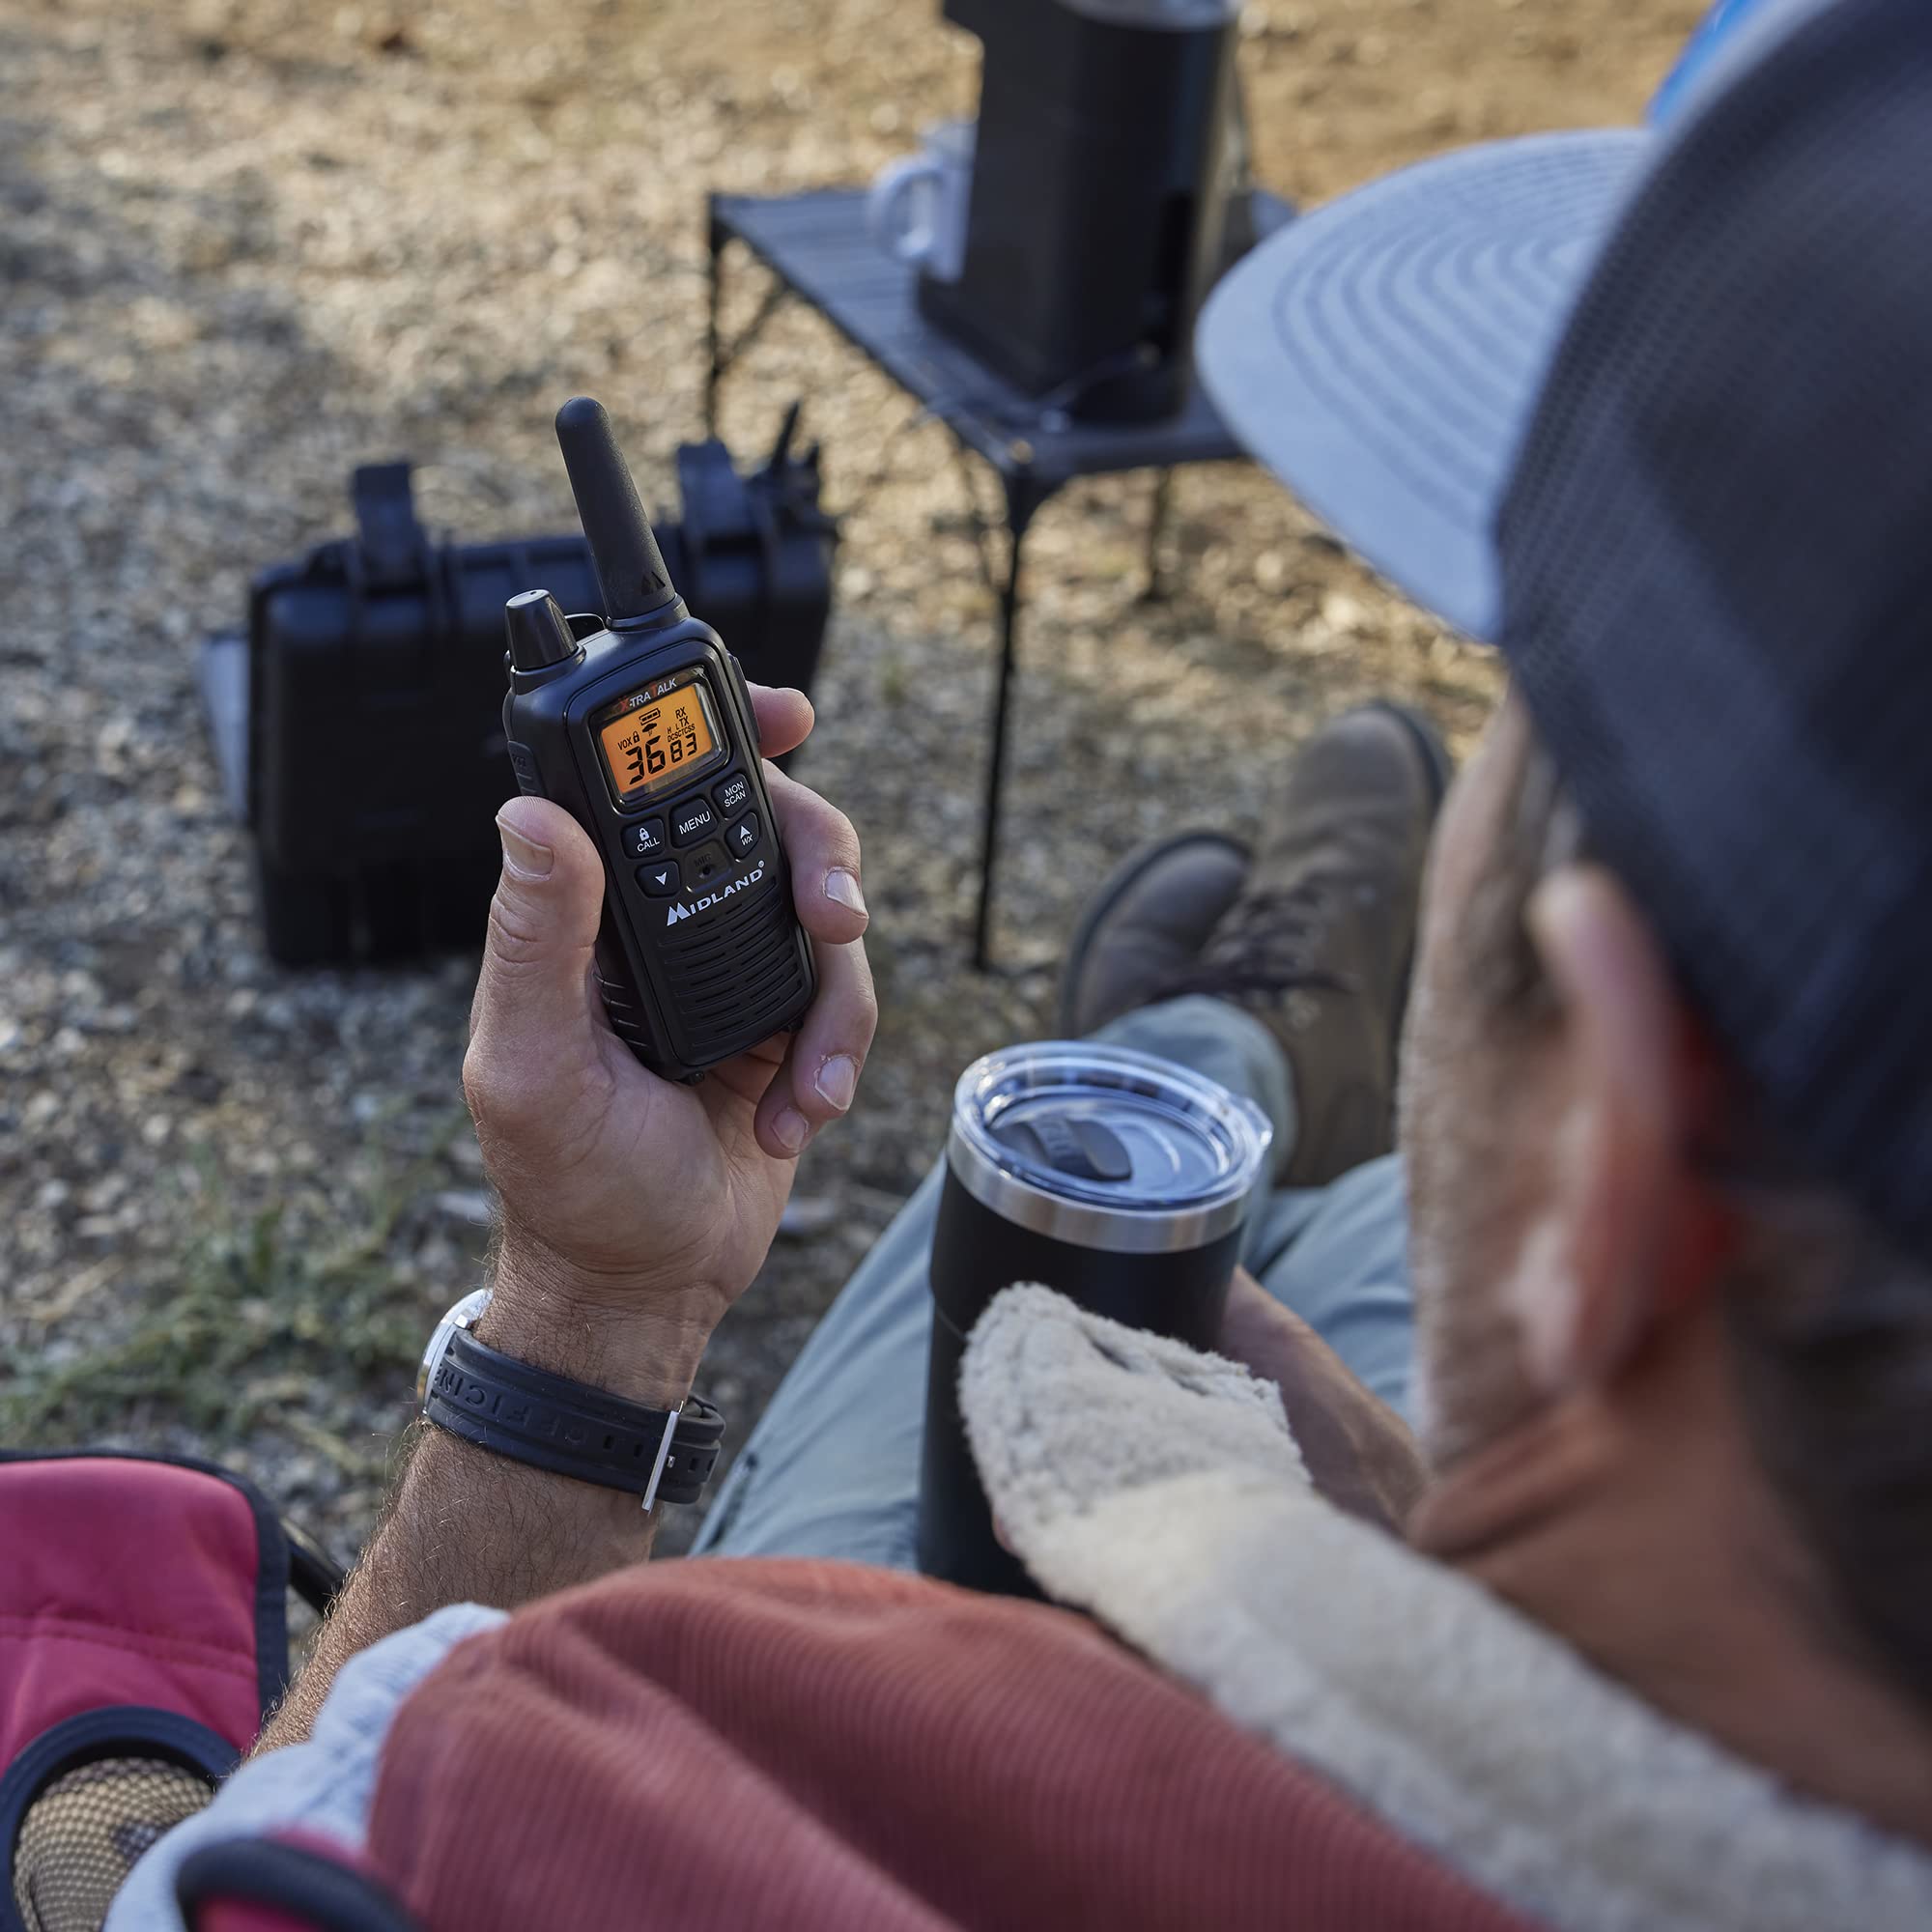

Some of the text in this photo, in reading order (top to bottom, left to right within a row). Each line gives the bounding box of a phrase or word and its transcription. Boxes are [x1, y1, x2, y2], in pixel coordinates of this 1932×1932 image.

[675, 706, 686, 719] RX
[678, 716, 690, 727] TX
[617, 736, 633, 751] VOX
[625, 733, 697, 784] 36 83
[724, 781, 744, 797] MON
[724, 790, 746, 808] SCAN
[679, 811, 711, 835] MENU
[637, 837, 660, 852] CALL
[741, 834, 753, 846] WX
[694, 853, 712, 867] MIC
[667, 868, 763, 926] MIDLAND
